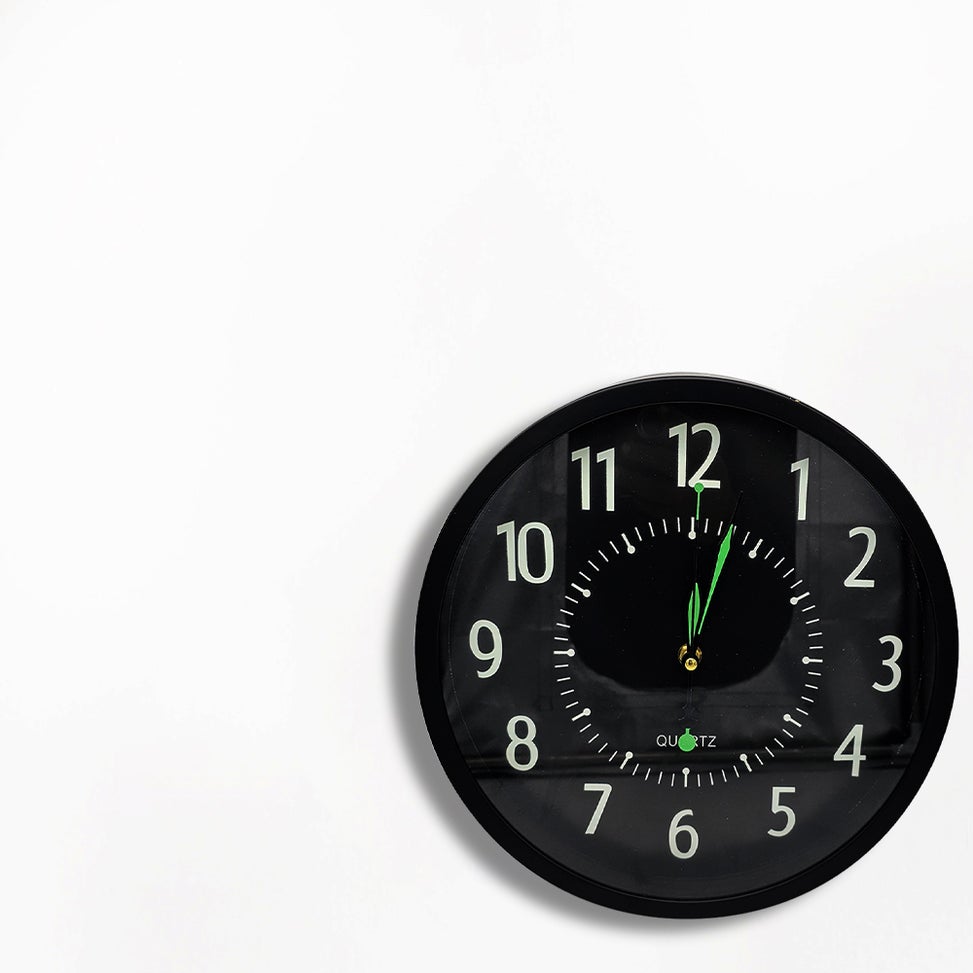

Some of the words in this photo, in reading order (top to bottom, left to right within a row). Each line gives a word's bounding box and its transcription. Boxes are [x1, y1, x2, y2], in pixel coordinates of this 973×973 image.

[571, 446, 615, 512] 11
[668, 422, 721, 489] 12
[790, 457, 810, 521] 1
[496, 520, 555, 584] 10
[843, 526, 877, 588] 2
[469, 619, 503, 679] 9
[871, 634, 903, 693] 3
[505, 715, 539, 772] 8
[656, 734, 717, 748] QURTZ
[833, 724, 867, 777] 4
[583, 782, 613, 835] 7
[668, 808, 699, 859] 6
[767, 786, 796, 837] 5
